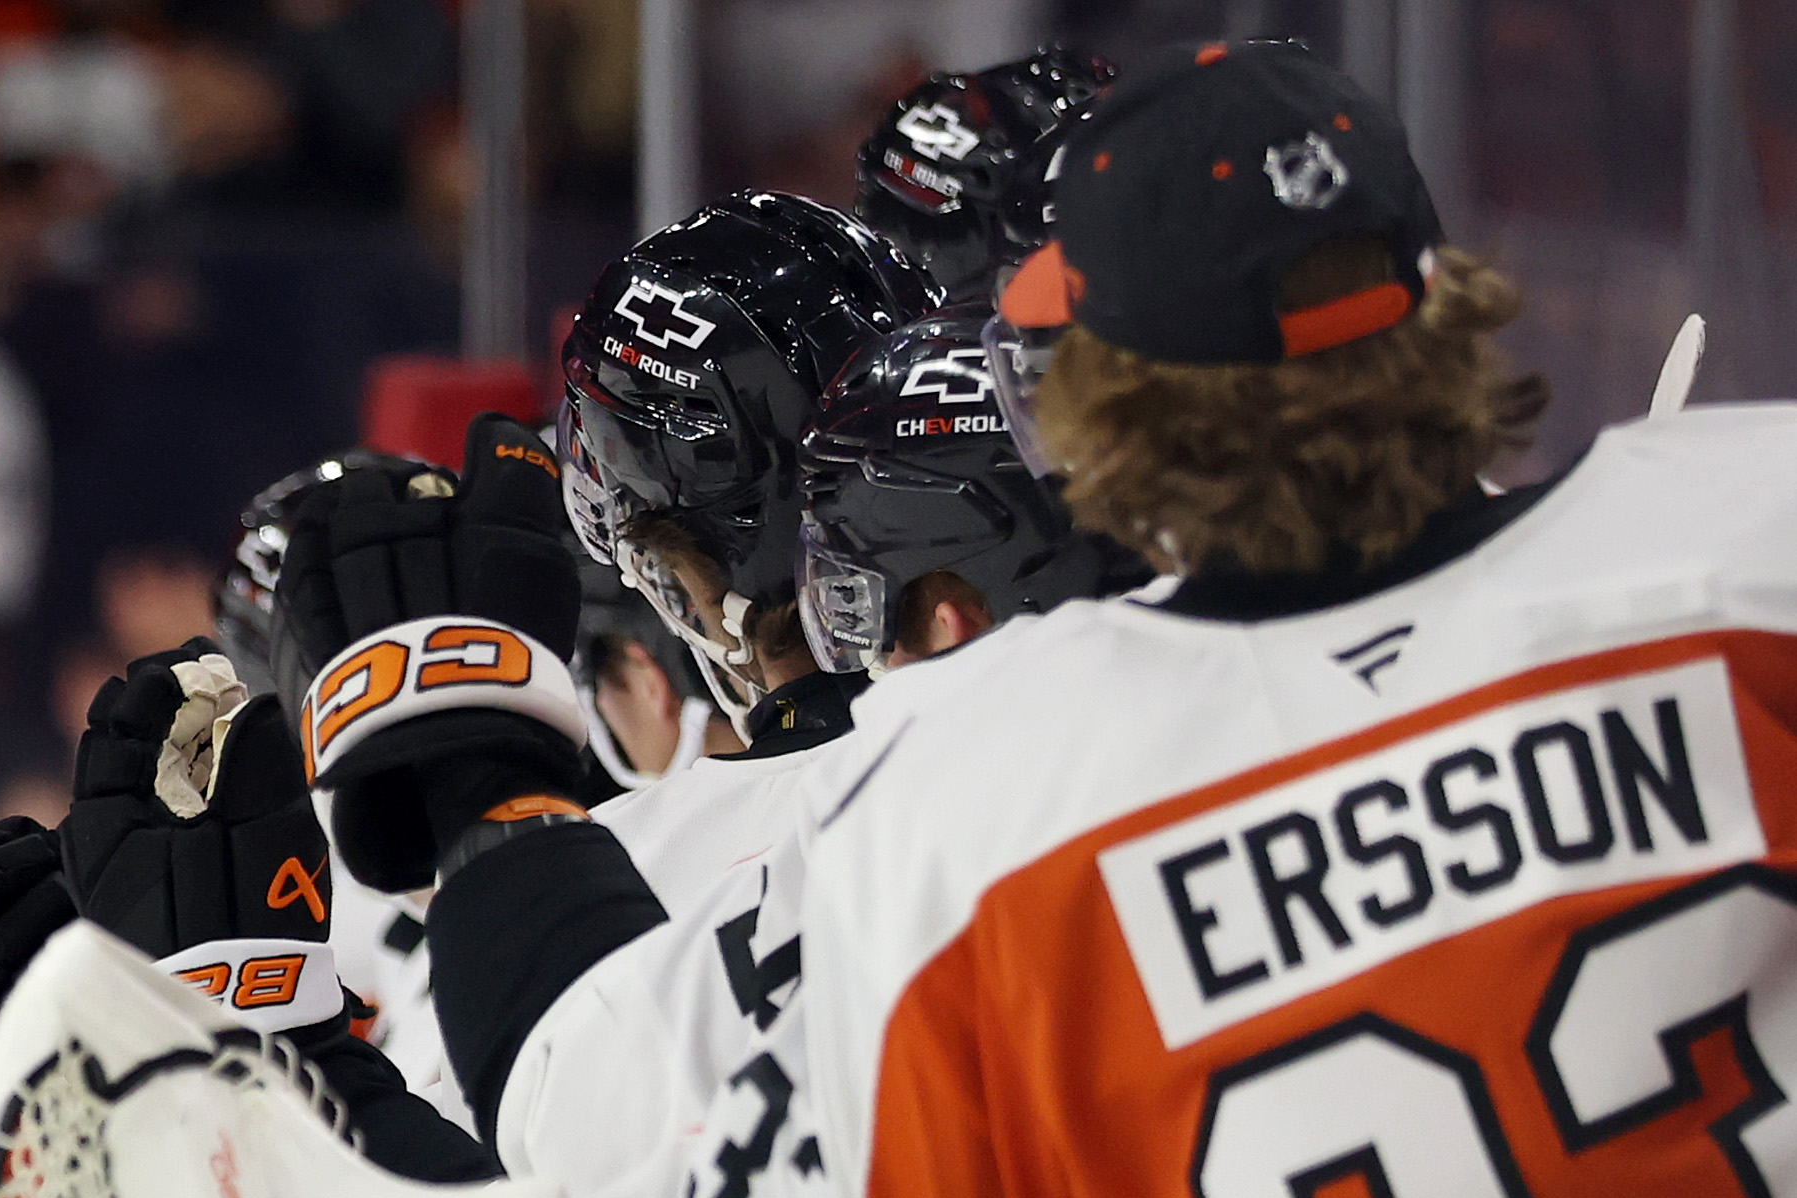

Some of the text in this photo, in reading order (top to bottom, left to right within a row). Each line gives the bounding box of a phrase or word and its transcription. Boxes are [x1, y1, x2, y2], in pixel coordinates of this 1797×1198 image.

[603, 336, 701, 390] CHEVROLET
[300, 625, 531, 786] CC
[1158, 696, 1710, 1003] ERSSON
